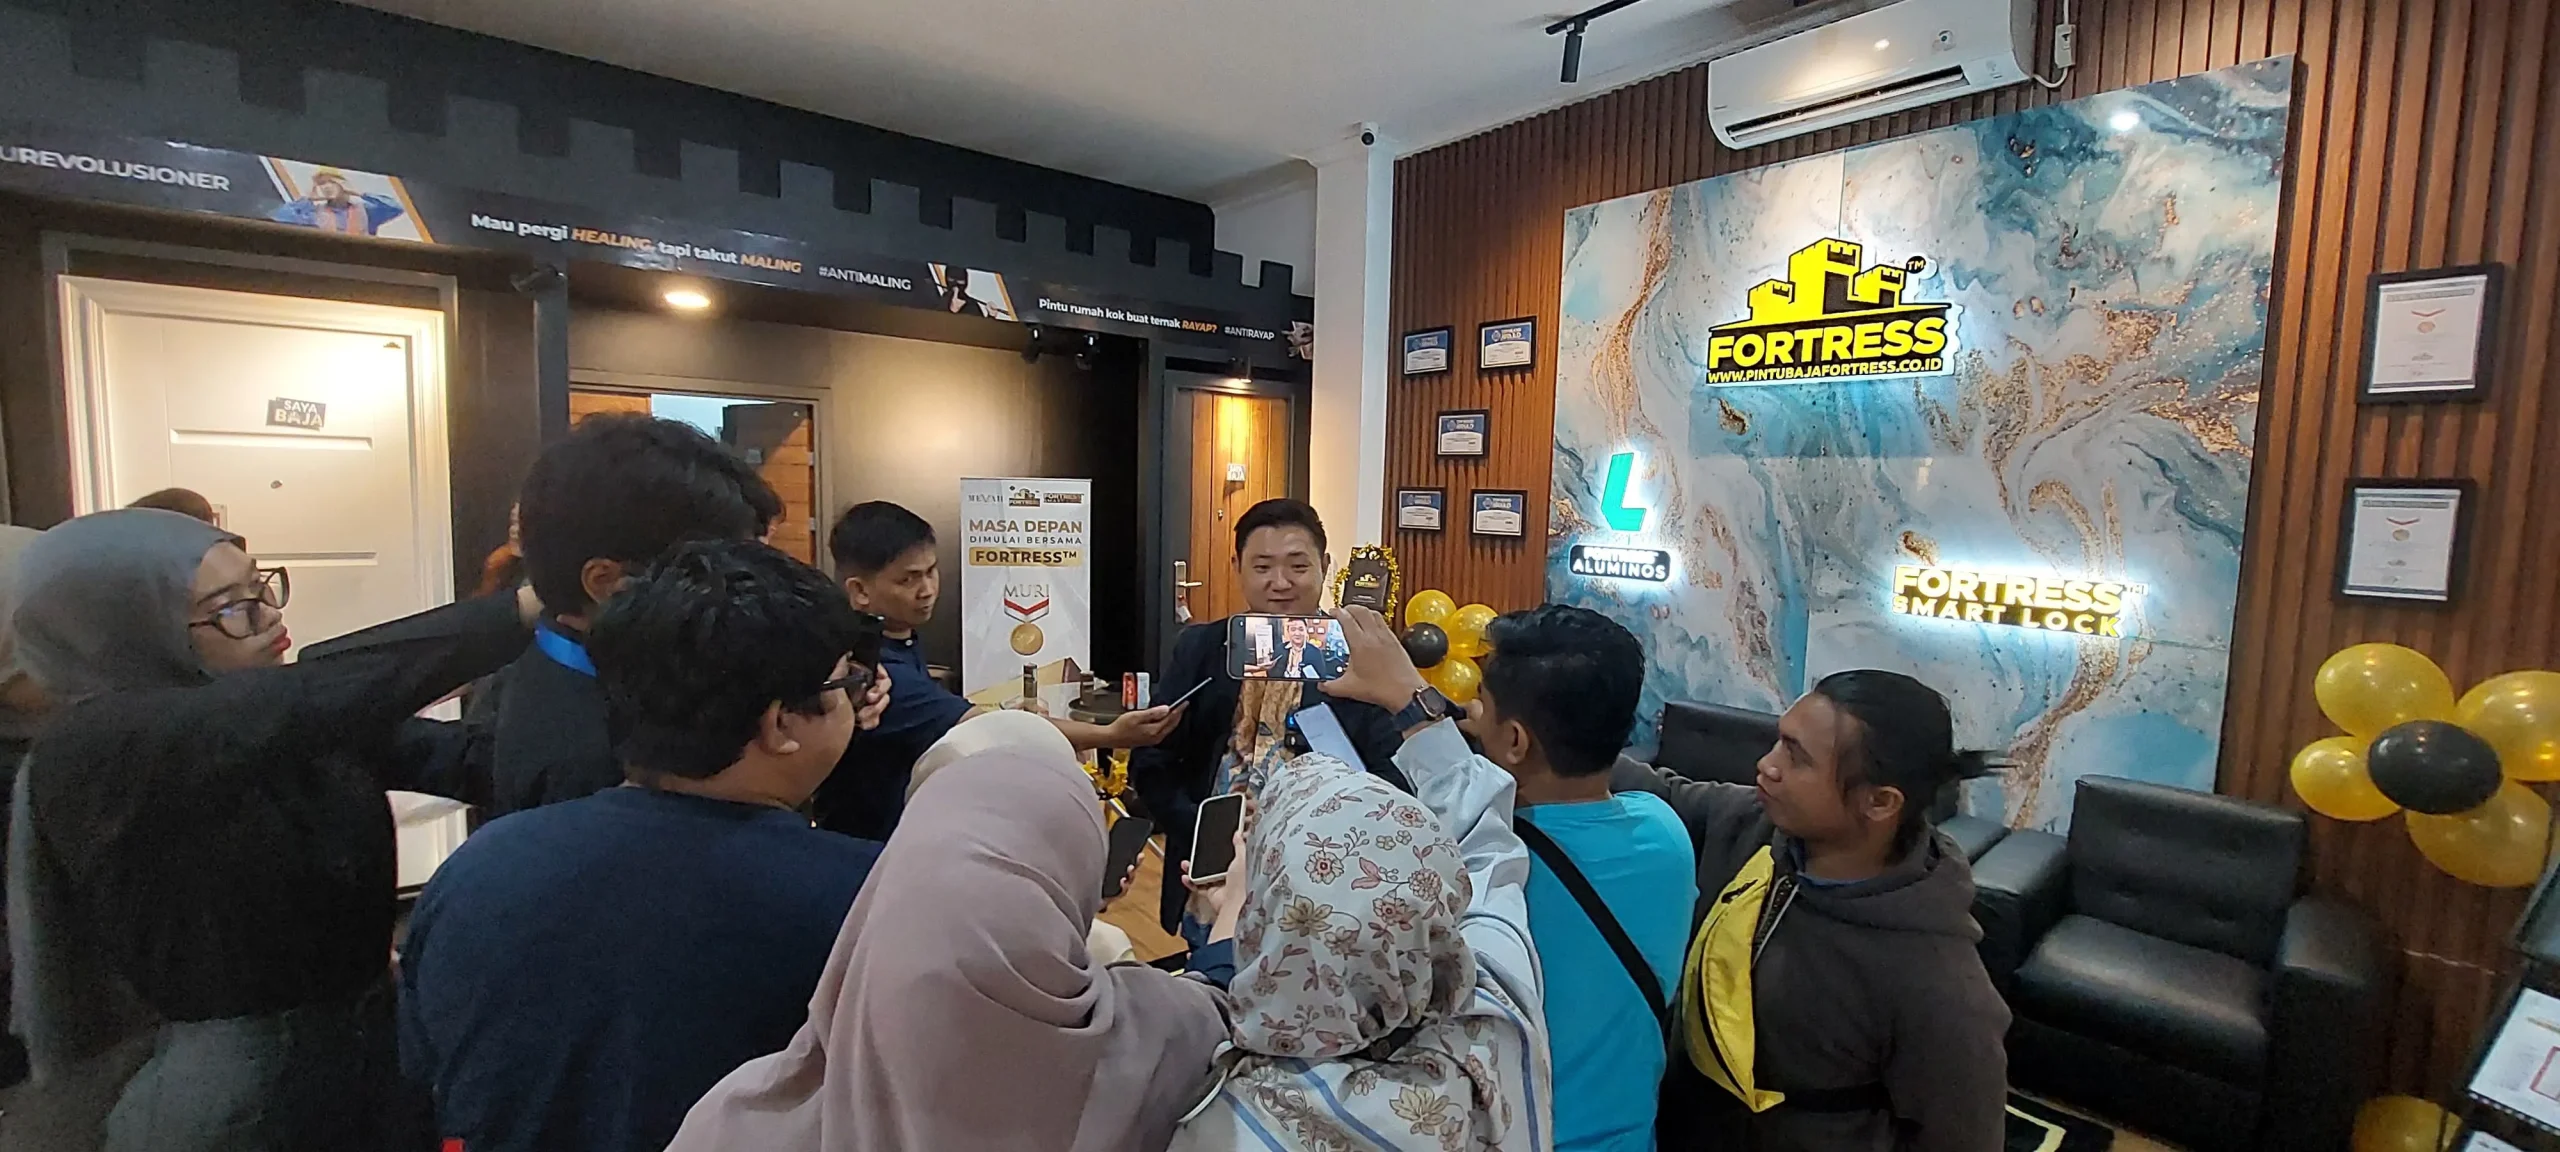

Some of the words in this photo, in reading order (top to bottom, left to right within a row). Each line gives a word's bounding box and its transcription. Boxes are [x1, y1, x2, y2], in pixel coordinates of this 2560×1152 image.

[471, 213, 515, 232] Mau
[518, 222, 569, 241] pergi
[657, 241, 691, 259] tapi
[694, 246, 738, 264] takut
[740, 253, 802, 273] MALING
[819, 265, 912, 290] #ANTIMALING
[1039, 298, 1068, 312] Pintu
[1070, 304, 1104, 318] rumah
[1105, 309, 1125, 321] kok
[1126, 312, 1149, 324] buat
[1150, 316, 1181, 329] ternak
[1182, 320, 1217, 334] RAYAP?
[1224, 326, 1275, 341] #ANTIRAYAP
[1708, 317, 1947, 370] FORTRESS
[1708, 358, 1942, 384] WWW.PINTUBAJAFORTRESS.CO.ID
[275, 408, 323, 426] BAJA
[284, 399, 318, 414] SAYA
[969, 519, 1019, 533] MASA
[1024, 520, 1083, 533] DEPAN
[969, 536, 1020, 544] DIMULAI
[1026, 536, 1083, 544] BERSAMA
[1572, 559, 1666, 580] ALUMINOS
[1003, 583, 1050, 598] MURI
[1892, 595, 2007, 625] SMART
[2022, 607, 2122, 638] LOCK
